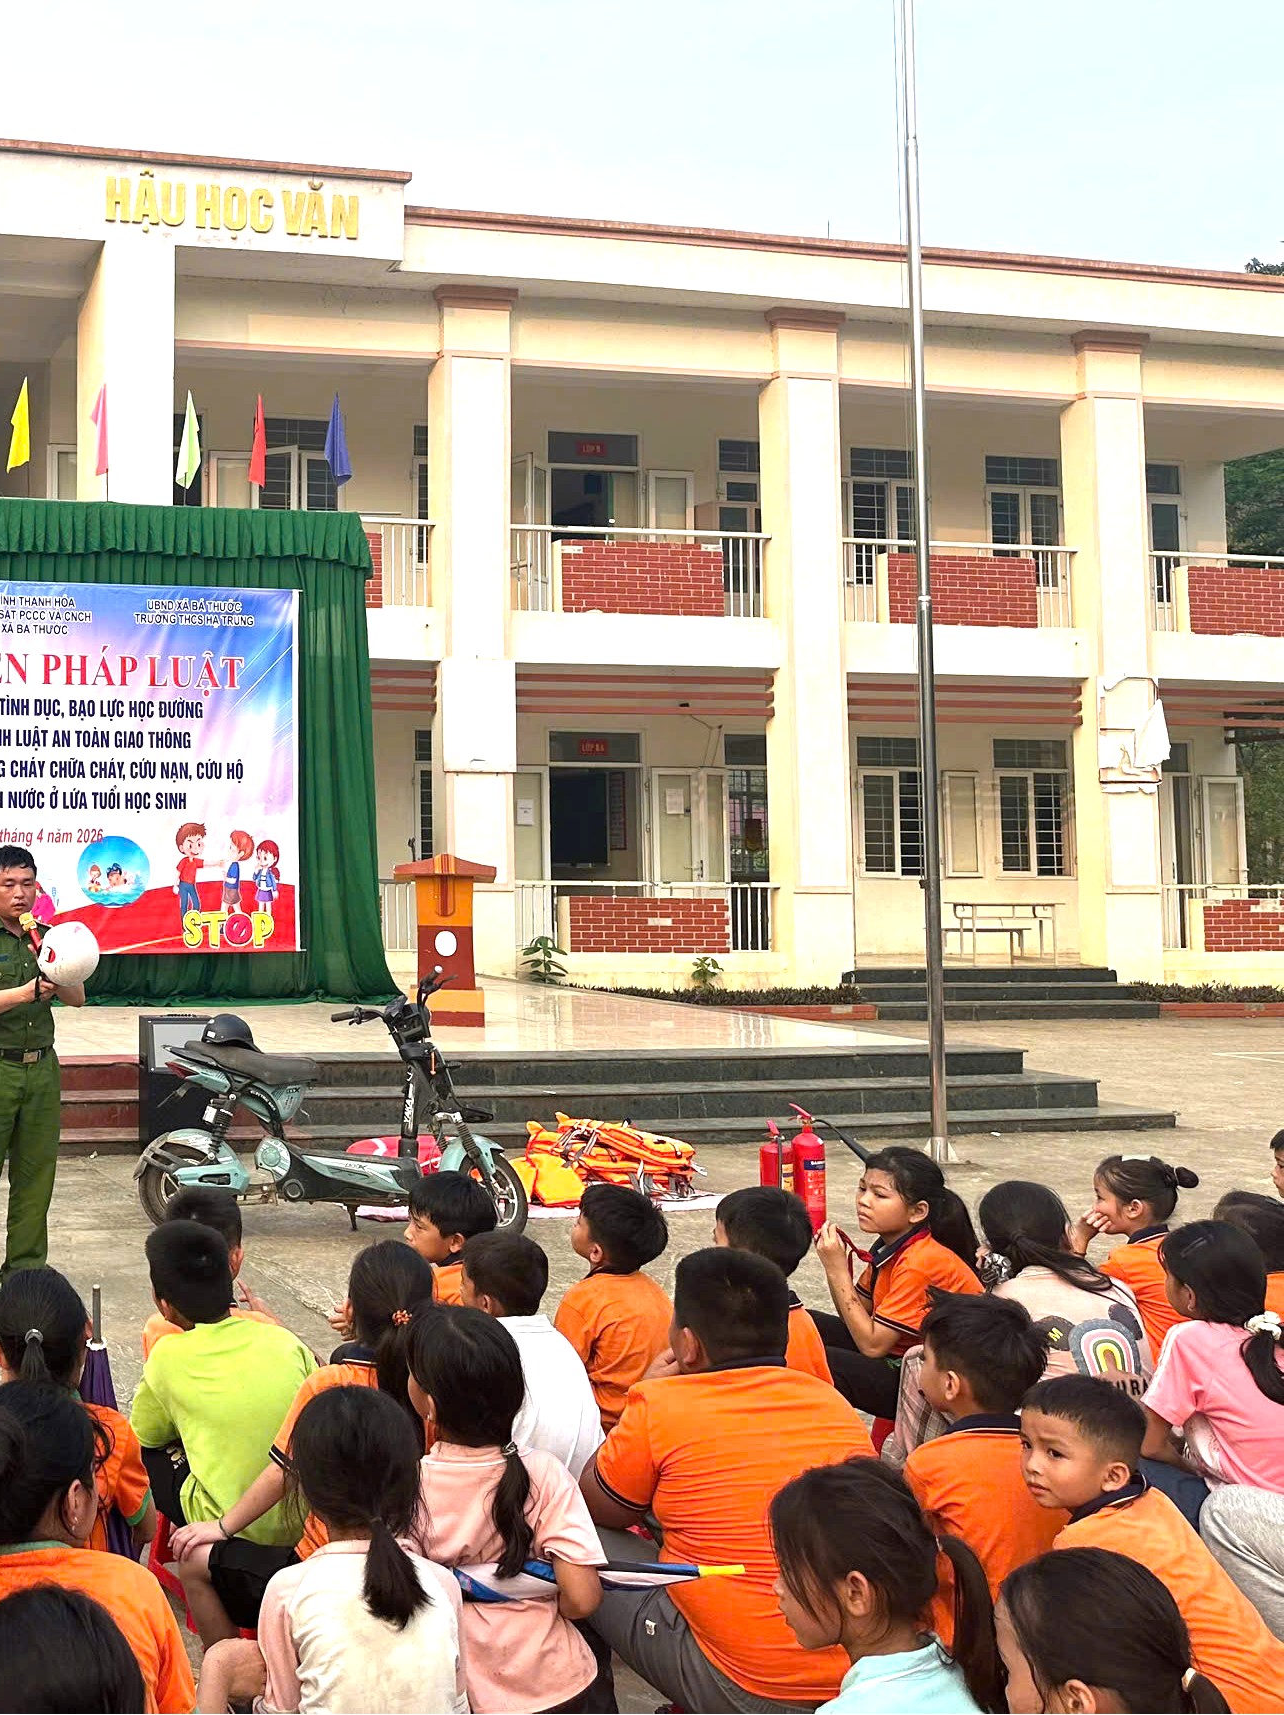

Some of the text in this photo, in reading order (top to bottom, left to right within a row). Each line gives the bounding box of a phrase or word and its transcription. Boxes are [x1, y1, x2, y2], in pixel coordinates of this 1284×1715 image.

[105, 168, 360, 240] HẬU HỌC VĂN
[41, 645, 138, 686] PHÁP
[147, 652, 244, 697] LUẬT
[0, 694, 30, 717] TÌNH
[34, 698, 65, 720] DỤC,
[69, 699, 96, 721] BẠO
[100, 698, 125, 722] LỰC
[128, 700, 154, 722] HỌC
[158, 697, 204, 719] ĐƯỜNG
[16, 725, 48, 751] LUẬT
[52, 729, 71, 748] AN
[75, 726, 110, 748] TOÀN
[114, 730, 144, 749] GIAO
[148, 727, 192, 749] THÔNG
[10, 757, 46, 779] CHÁY
[49, 757, 86, 779] CHỮA
[89, 757, 126, 781] CHÁY,
[130, 759, 157, 780] CỨU
[160, 761, 193, 783] NẠN,
[196, 760, 222, 780] CỨU
[226, 758, 244, 783] HỘ
[8, 788, 45, 809] NƯỚC
[49, 785, 59, 809] Ở
[63, 788, 88, 810] LỨA
[91, 785, 121, 810] TUỔI
[124, 791, 151, 813] HỌC
[155, 792, 187, 810] SINH
[0, 828, 33, 847] tháng
[36, 829, 44, 843] 4
[47, 828, 73, 843] năm
[76, 829, 104, 844] 2026
[182, 909, 275, 949] STOP
